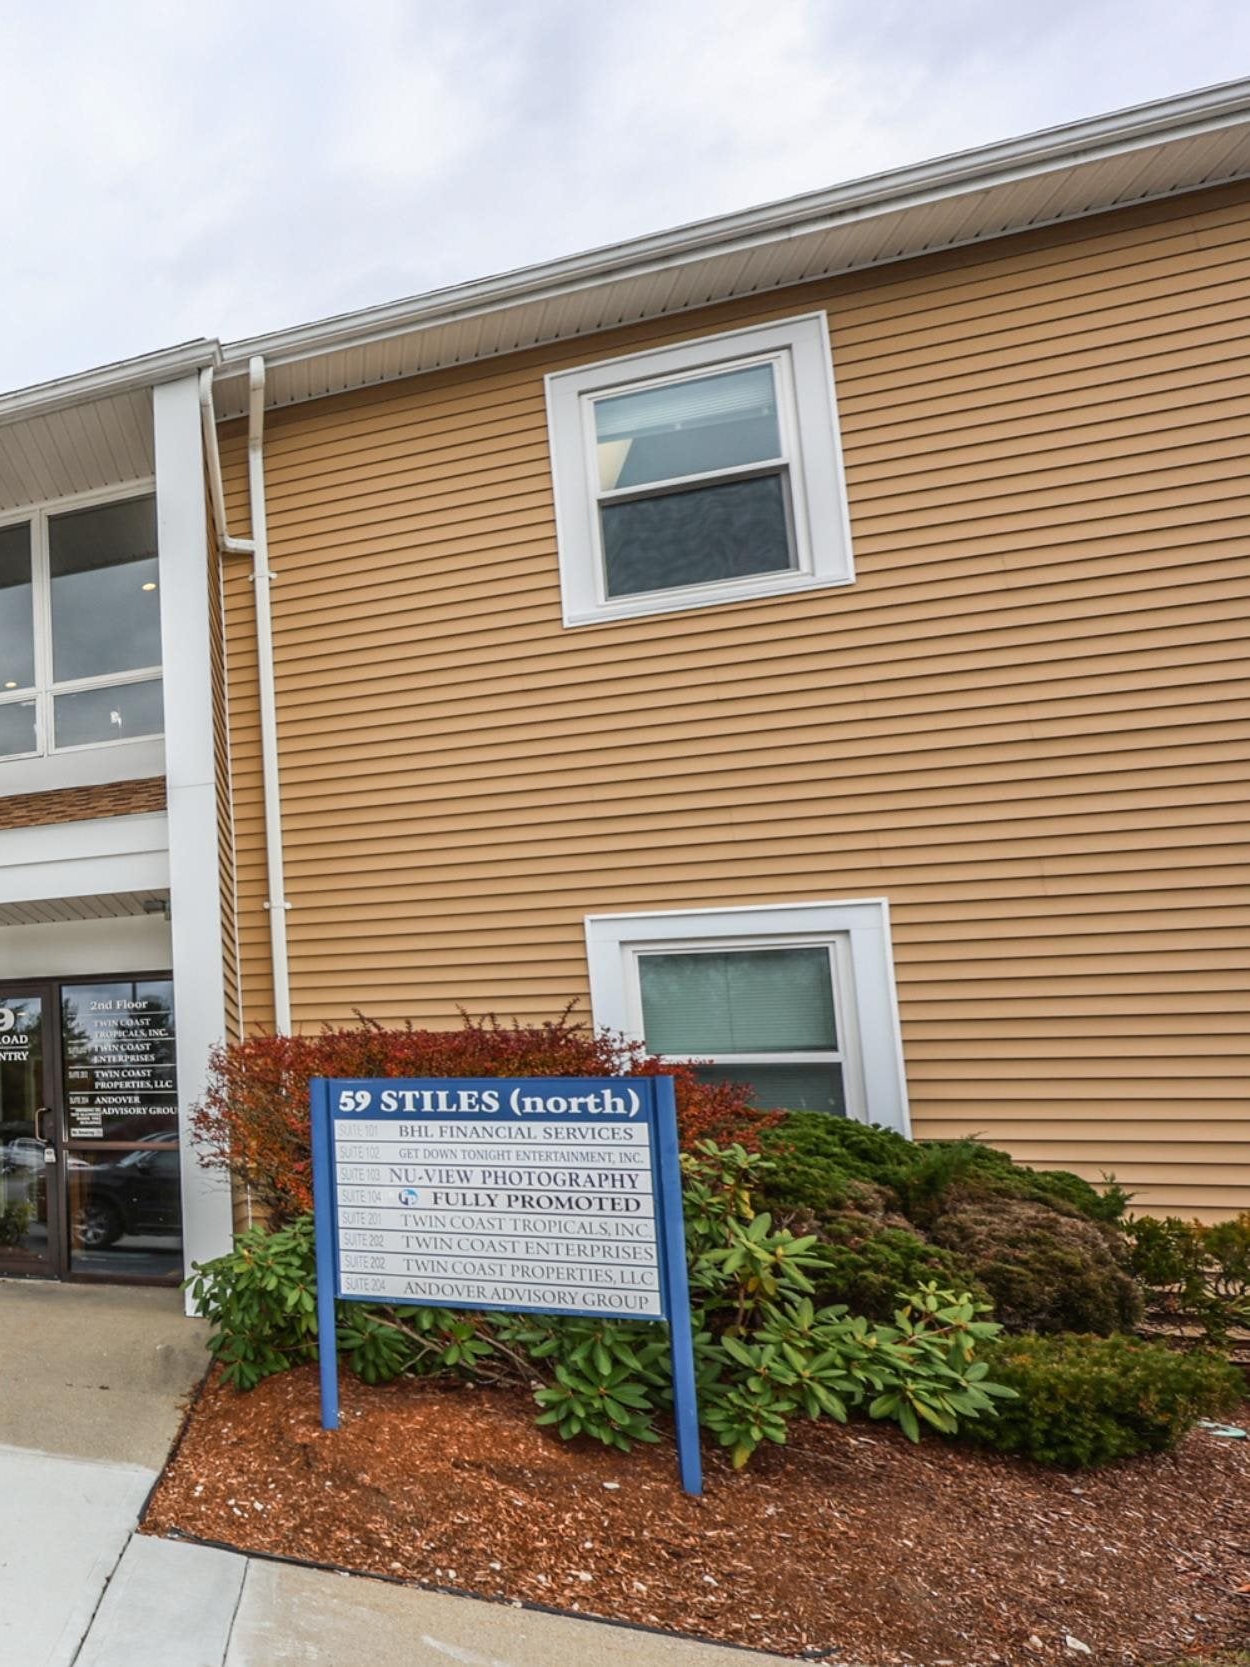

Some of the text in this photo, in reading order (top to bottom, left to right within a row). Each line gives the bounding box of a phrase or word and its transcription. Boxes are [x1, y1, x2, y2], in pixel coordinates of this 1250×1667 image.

[90, 999, 148, 1010] 2nd Floor
[94, 1018, 151, 1027] TWIN COAST
[148, 1028, 169, 1037] INC.
[94, 1044, 119, 1052] TWIN
[120, 1043, 152, 1051] COAST
[93, 1053, 156, 1063] ENTERPRISES
[94, 1069, 121, 1078] TWIN
[121, 1069, 152, 1077] COAST
[94, 1080, 173, 1089] PROPERTIES, LLC
[94, 1096, 141, 1104] ANDOVER
[339, 1087, 641, 1118] 59 STILES (north)
[101, 1106, 177, 1115] ADVISORY GROU
[339, 1123, 634, 1141] SUITE 101 BHL FINANCIAL SERVICES
[339, 1145, 644, 1164] SUITE 102 GET DOWN TONIGHT ENTERTAINMENT, INC.
[341, 1167, 639, 1190] SUITE 103 NU-VIEW PHOTOGRAPHY
[342, 1188, 641, 1212] SUITE 104 FULLY PROMOTED
[342, 1211, 653, 1238] SUITE 201 TWIN COAST TROPICALS, INC.
[343, 1233, 654, 1261] SUITE 202 TWIN COAST ENTERPRISES
[344, 1255, 654, 1286] SUITE 202 TWIN COAST PROPERTIES, LLC
[345, 1277, 649, 1310] SUITE 204 ANDOVER ADVISORY GROUP
